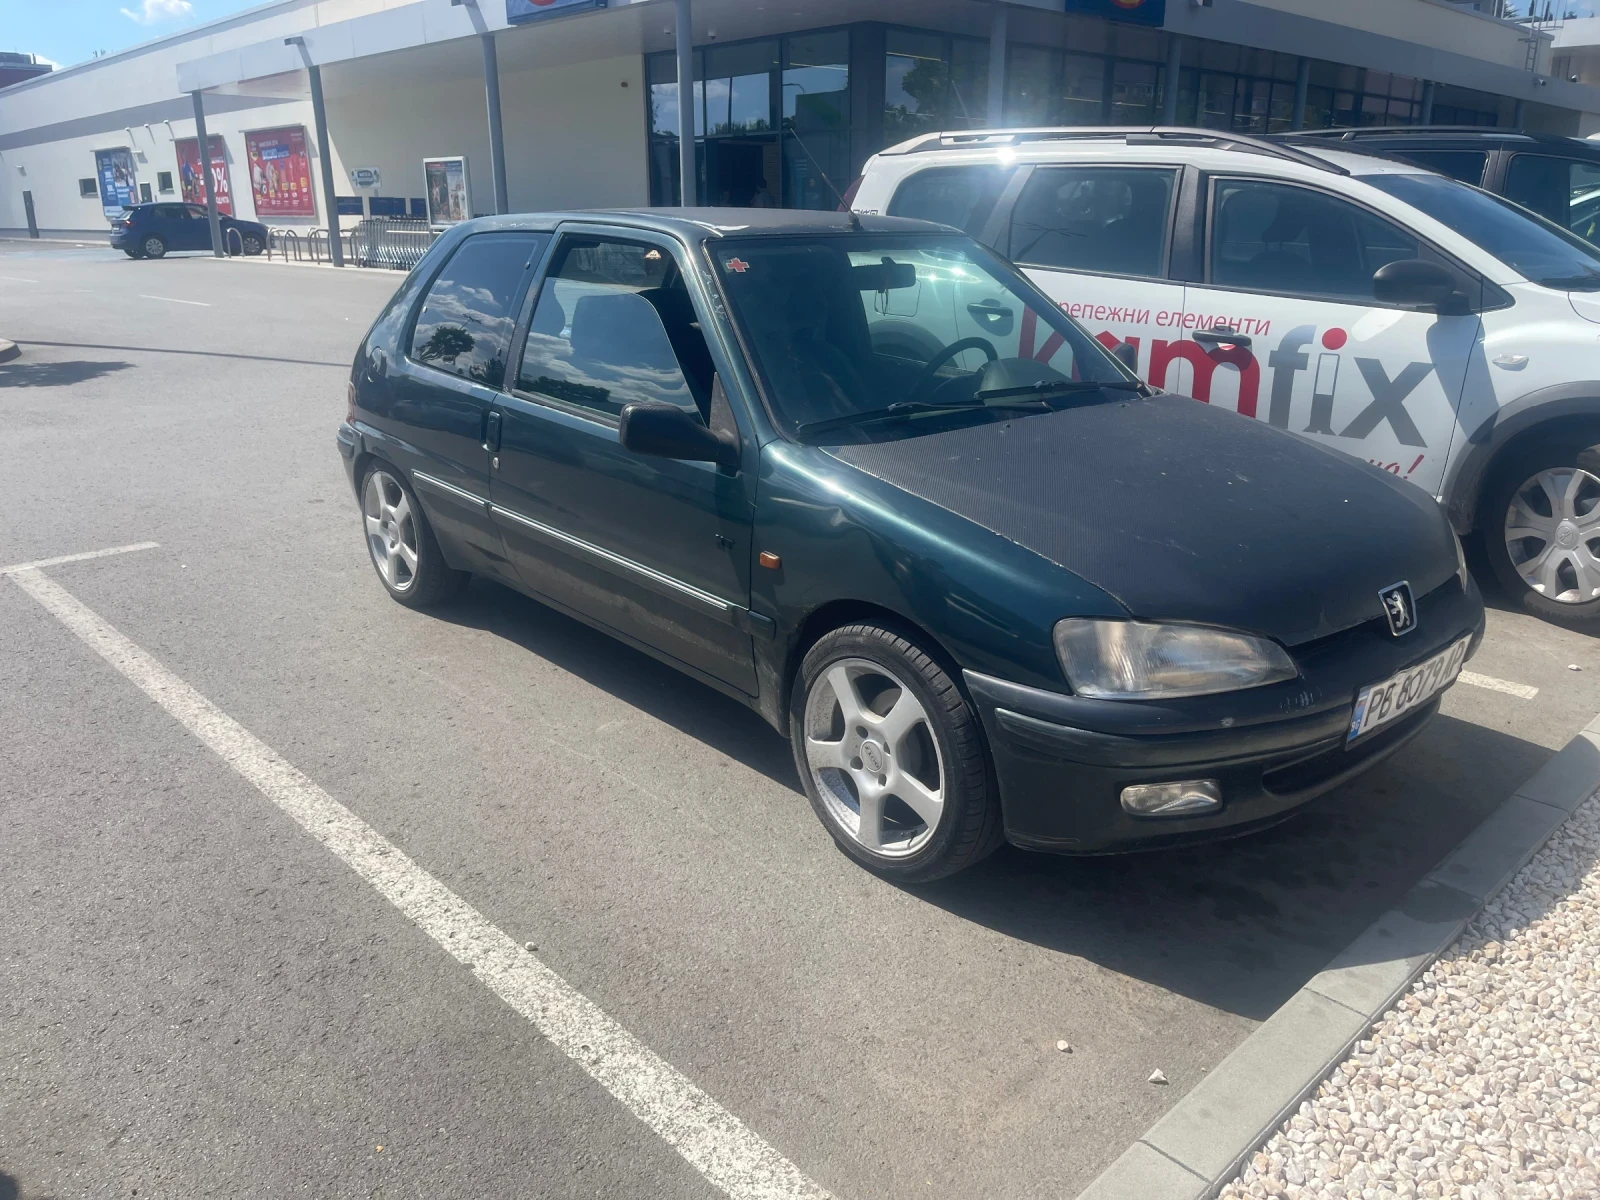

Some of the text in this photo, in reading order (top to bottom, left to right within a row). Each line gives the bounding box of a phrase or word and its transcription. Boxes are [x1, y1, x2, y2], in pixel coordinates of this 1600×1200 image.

[1056, 301, 1271, 336] репежни елементи
[1363, 683, 1397, 728] PB
[1395, 656, 1445, 710] 8079
